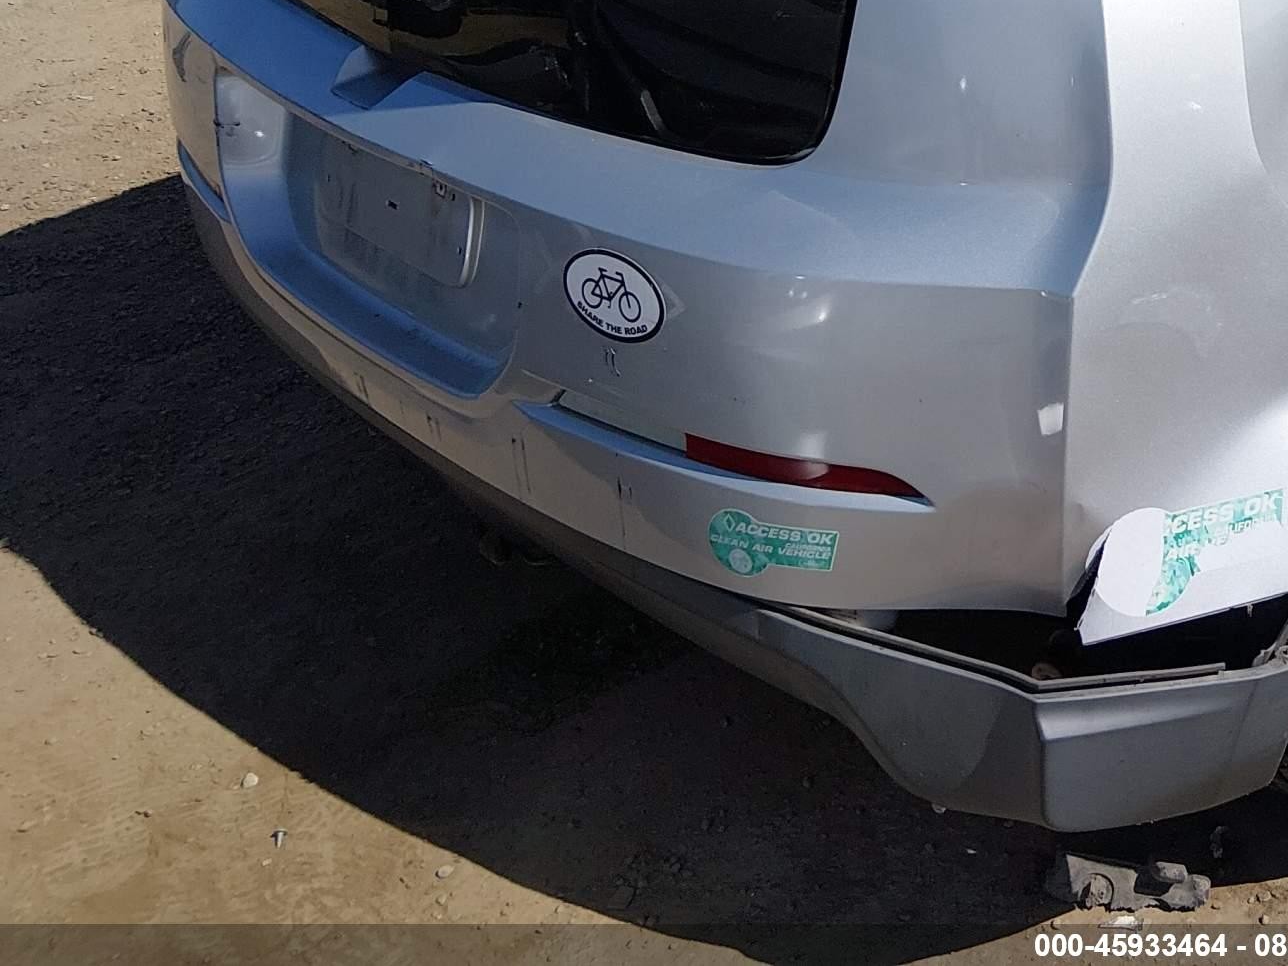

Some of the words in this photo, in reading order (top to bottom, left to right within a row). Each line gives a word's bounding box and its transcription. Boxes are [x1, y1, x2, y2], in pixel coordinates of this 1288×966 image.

[577, 301, 604, 327] SHARE
[605, 322, 623, 335] THE
[624, 324, 648, 336] ROAD
[1244, 491, 1279, 516] OK
[736, 521, 802, 542] ACCESS
[807, 532, 833, 545] OK
[710, 534, 750, 549] CLEAN
[752, 544, 774, 554] AIR
[778, 547, 832, 560] VEHICLE
